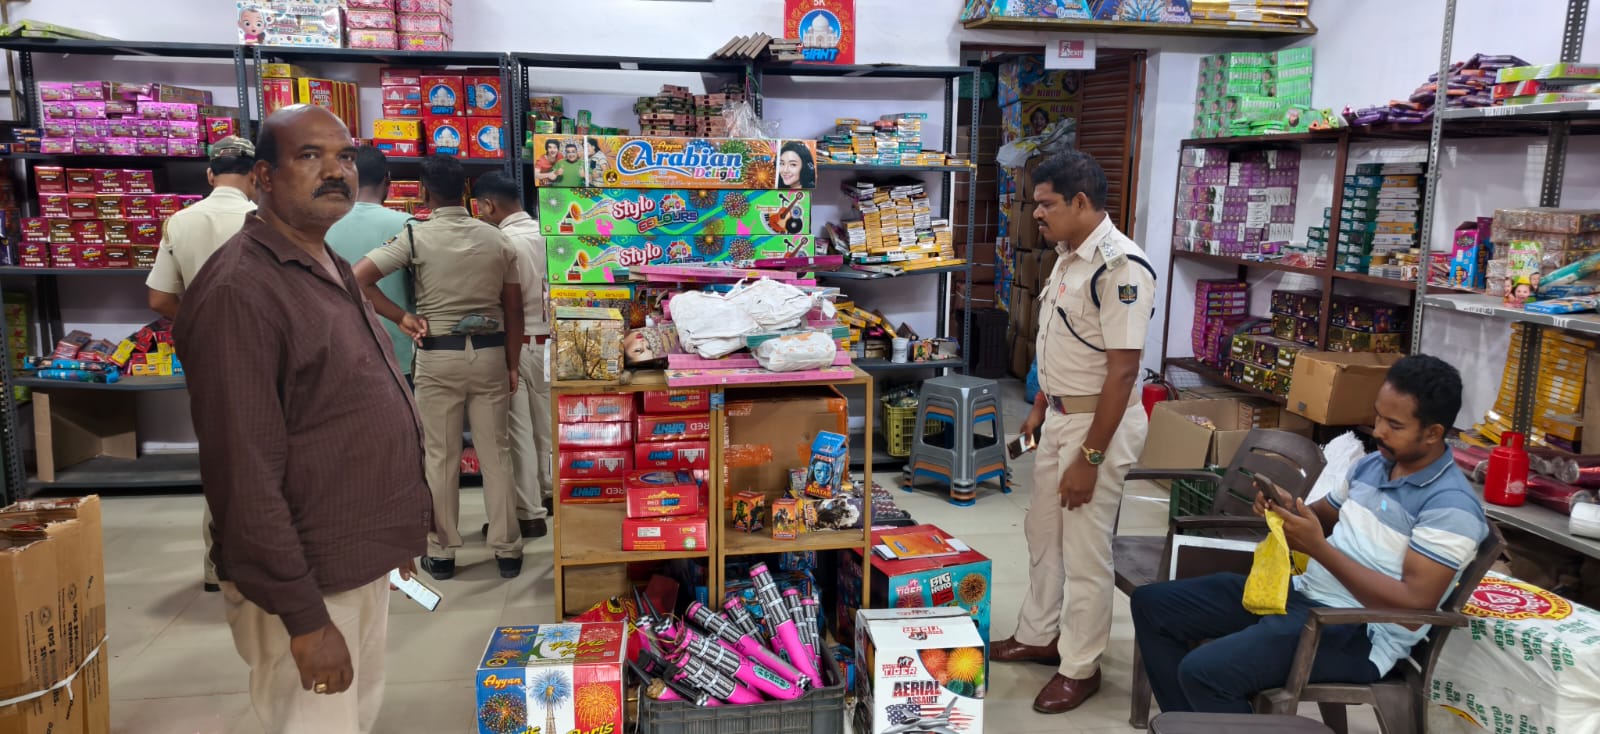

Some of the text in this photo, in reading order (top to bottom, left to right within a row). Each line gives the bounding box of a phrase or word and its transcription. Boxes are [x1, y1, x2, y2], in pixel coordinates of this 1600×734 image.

[802, 48, 840, 62] GIANT
[617, 140, 743, 175] Arabian
[694, 167, 740, 180] Delight
[612, 195, 656, 220] Stylo
[637, 210, 698, 233] COLOURS
[620, 242, 663, 267] Stylo
[652, 422, 686, 435] GIANT
[570, 486, 602, 497] GIANT
[930, 572, 951, 588] BIG
[931, 581, 952, 595] HERO
[884, 667, 917, 676] TIGER
[483, 674, 523, 690] Ayyan
[893, 681, 942, 698] AERIAL
[907, 696, 939, 705] ASSAULT
